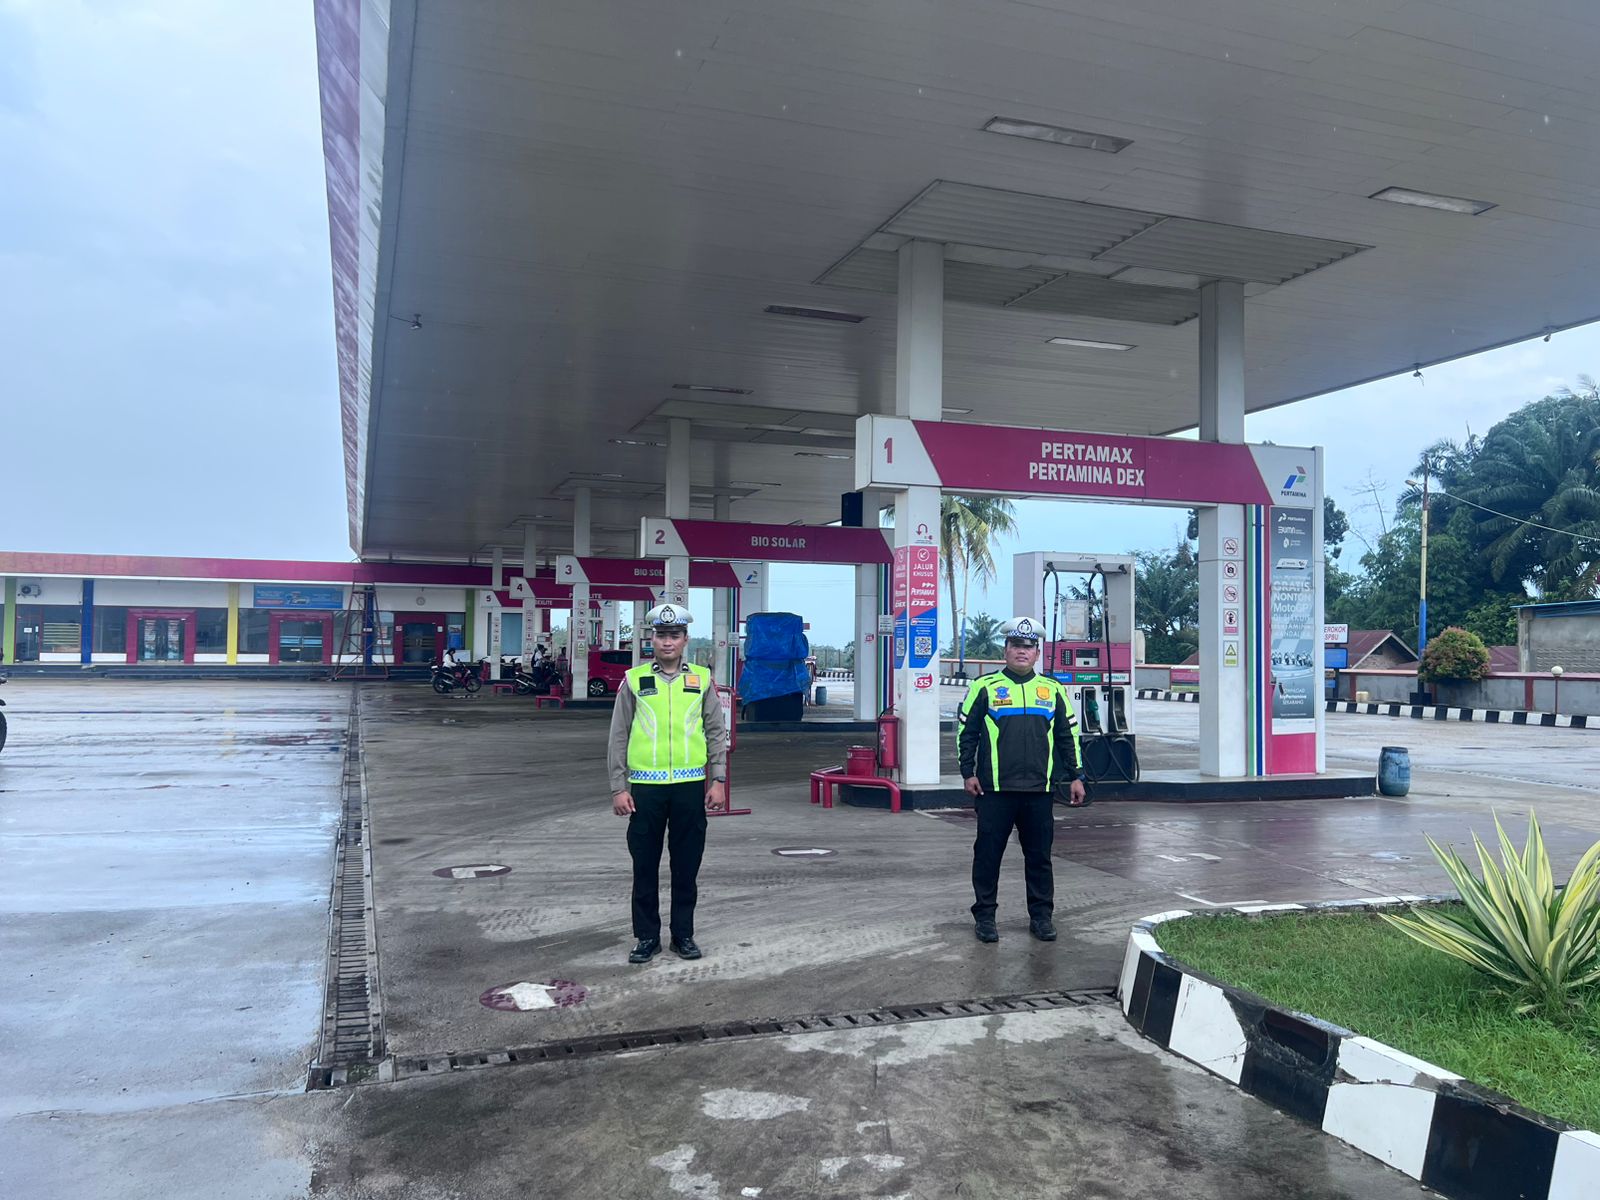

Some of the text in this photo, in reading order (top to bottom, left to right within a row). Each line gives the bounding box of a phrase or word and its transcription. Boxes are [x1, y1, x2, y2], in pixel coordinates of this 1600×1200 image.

[884, 437, 893, 464] 1
[1041, 442, 1133, 465] PERTAMAX
[1029, 462, 1145, 487] PERTAMINA DEX
[1280, 490, 1307, 498] PERTAMINA
[655, 529, 666, 545] 2
[751, 535, 806, 549] BIO SOLAR
[565, 565, 572, 575] 3
[634, 568, 664, 577] BIO SOL
[517, 583, 523, 592] 4
[1272, 580, 1310, 592] GRATIS
[911, 588, 935, 596] PERTAMAX
[486, 594, 492, 602] 5
[1273, 593, 1312, 601] NONTON
[1273, 602, 1309, 613] MotoGP
[1324, 625, 1346, 633] EROKOK
[1324, 633, 1339, 641] SPBU
[914, 678, 931, 687] 135
